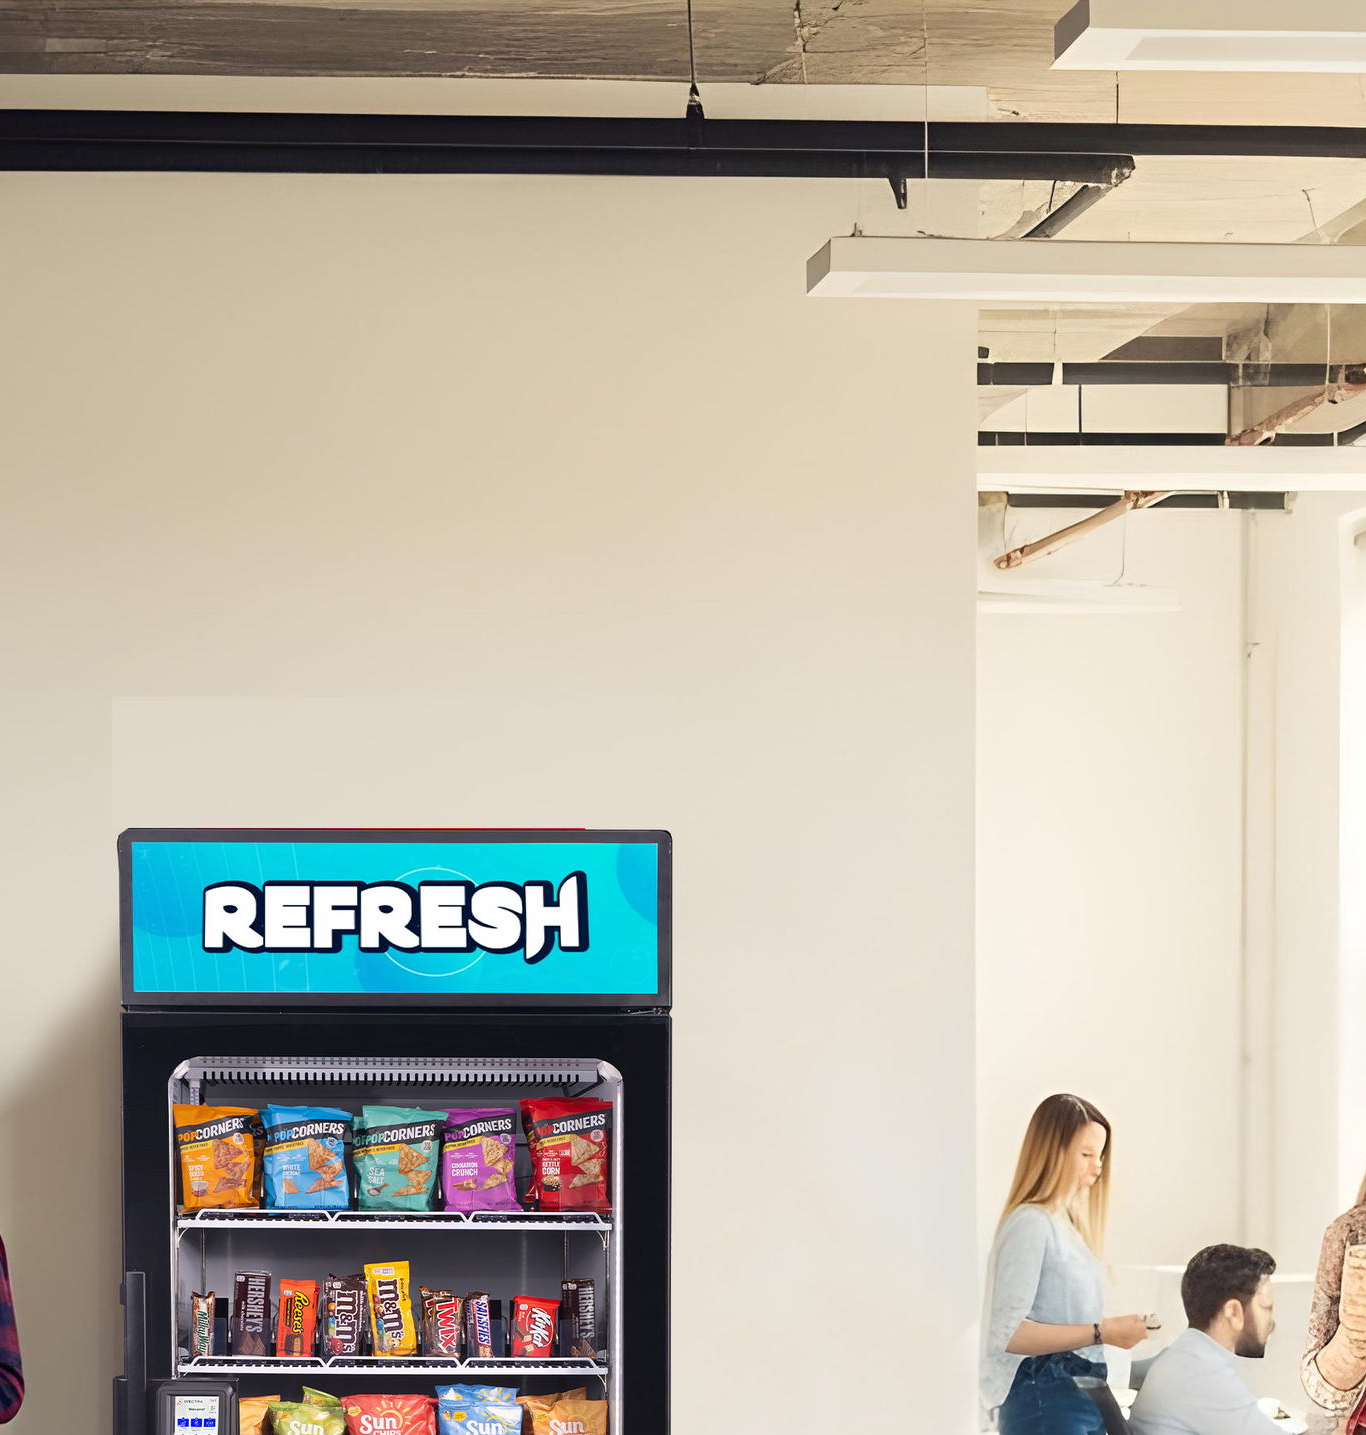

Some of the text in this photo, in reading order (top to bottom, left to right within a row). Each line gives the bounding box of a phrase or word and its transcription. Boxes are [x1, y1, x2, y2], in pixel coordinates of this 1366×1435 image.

[203, 873, 585, 963] REFRESH
[178, 1117, 245, 1144] POPCORNERS
[274, 1122, 344, 1142] POPCORNERS
[366, 1124, 435, 1147] POPCORNERS
[444, 1118, 512, 1141] POPCORNERS
[535, 1113, 606, 1139] POPCORNERS
[188, 1164, 204, 1172] SPICY
[368, 1167, 385, 1177] SEA
[451, 1168, 478, 1177] CRUNCH
[542, 1167, 561, 1175] CORN
[368, 1176, 385, 1185] SALT
[245, 1277, 266, 1333] HERSHEY'S
[578, 1286, 596, 1339] HERSHEY'S
[359, 1414, 398, 1434] Sun
